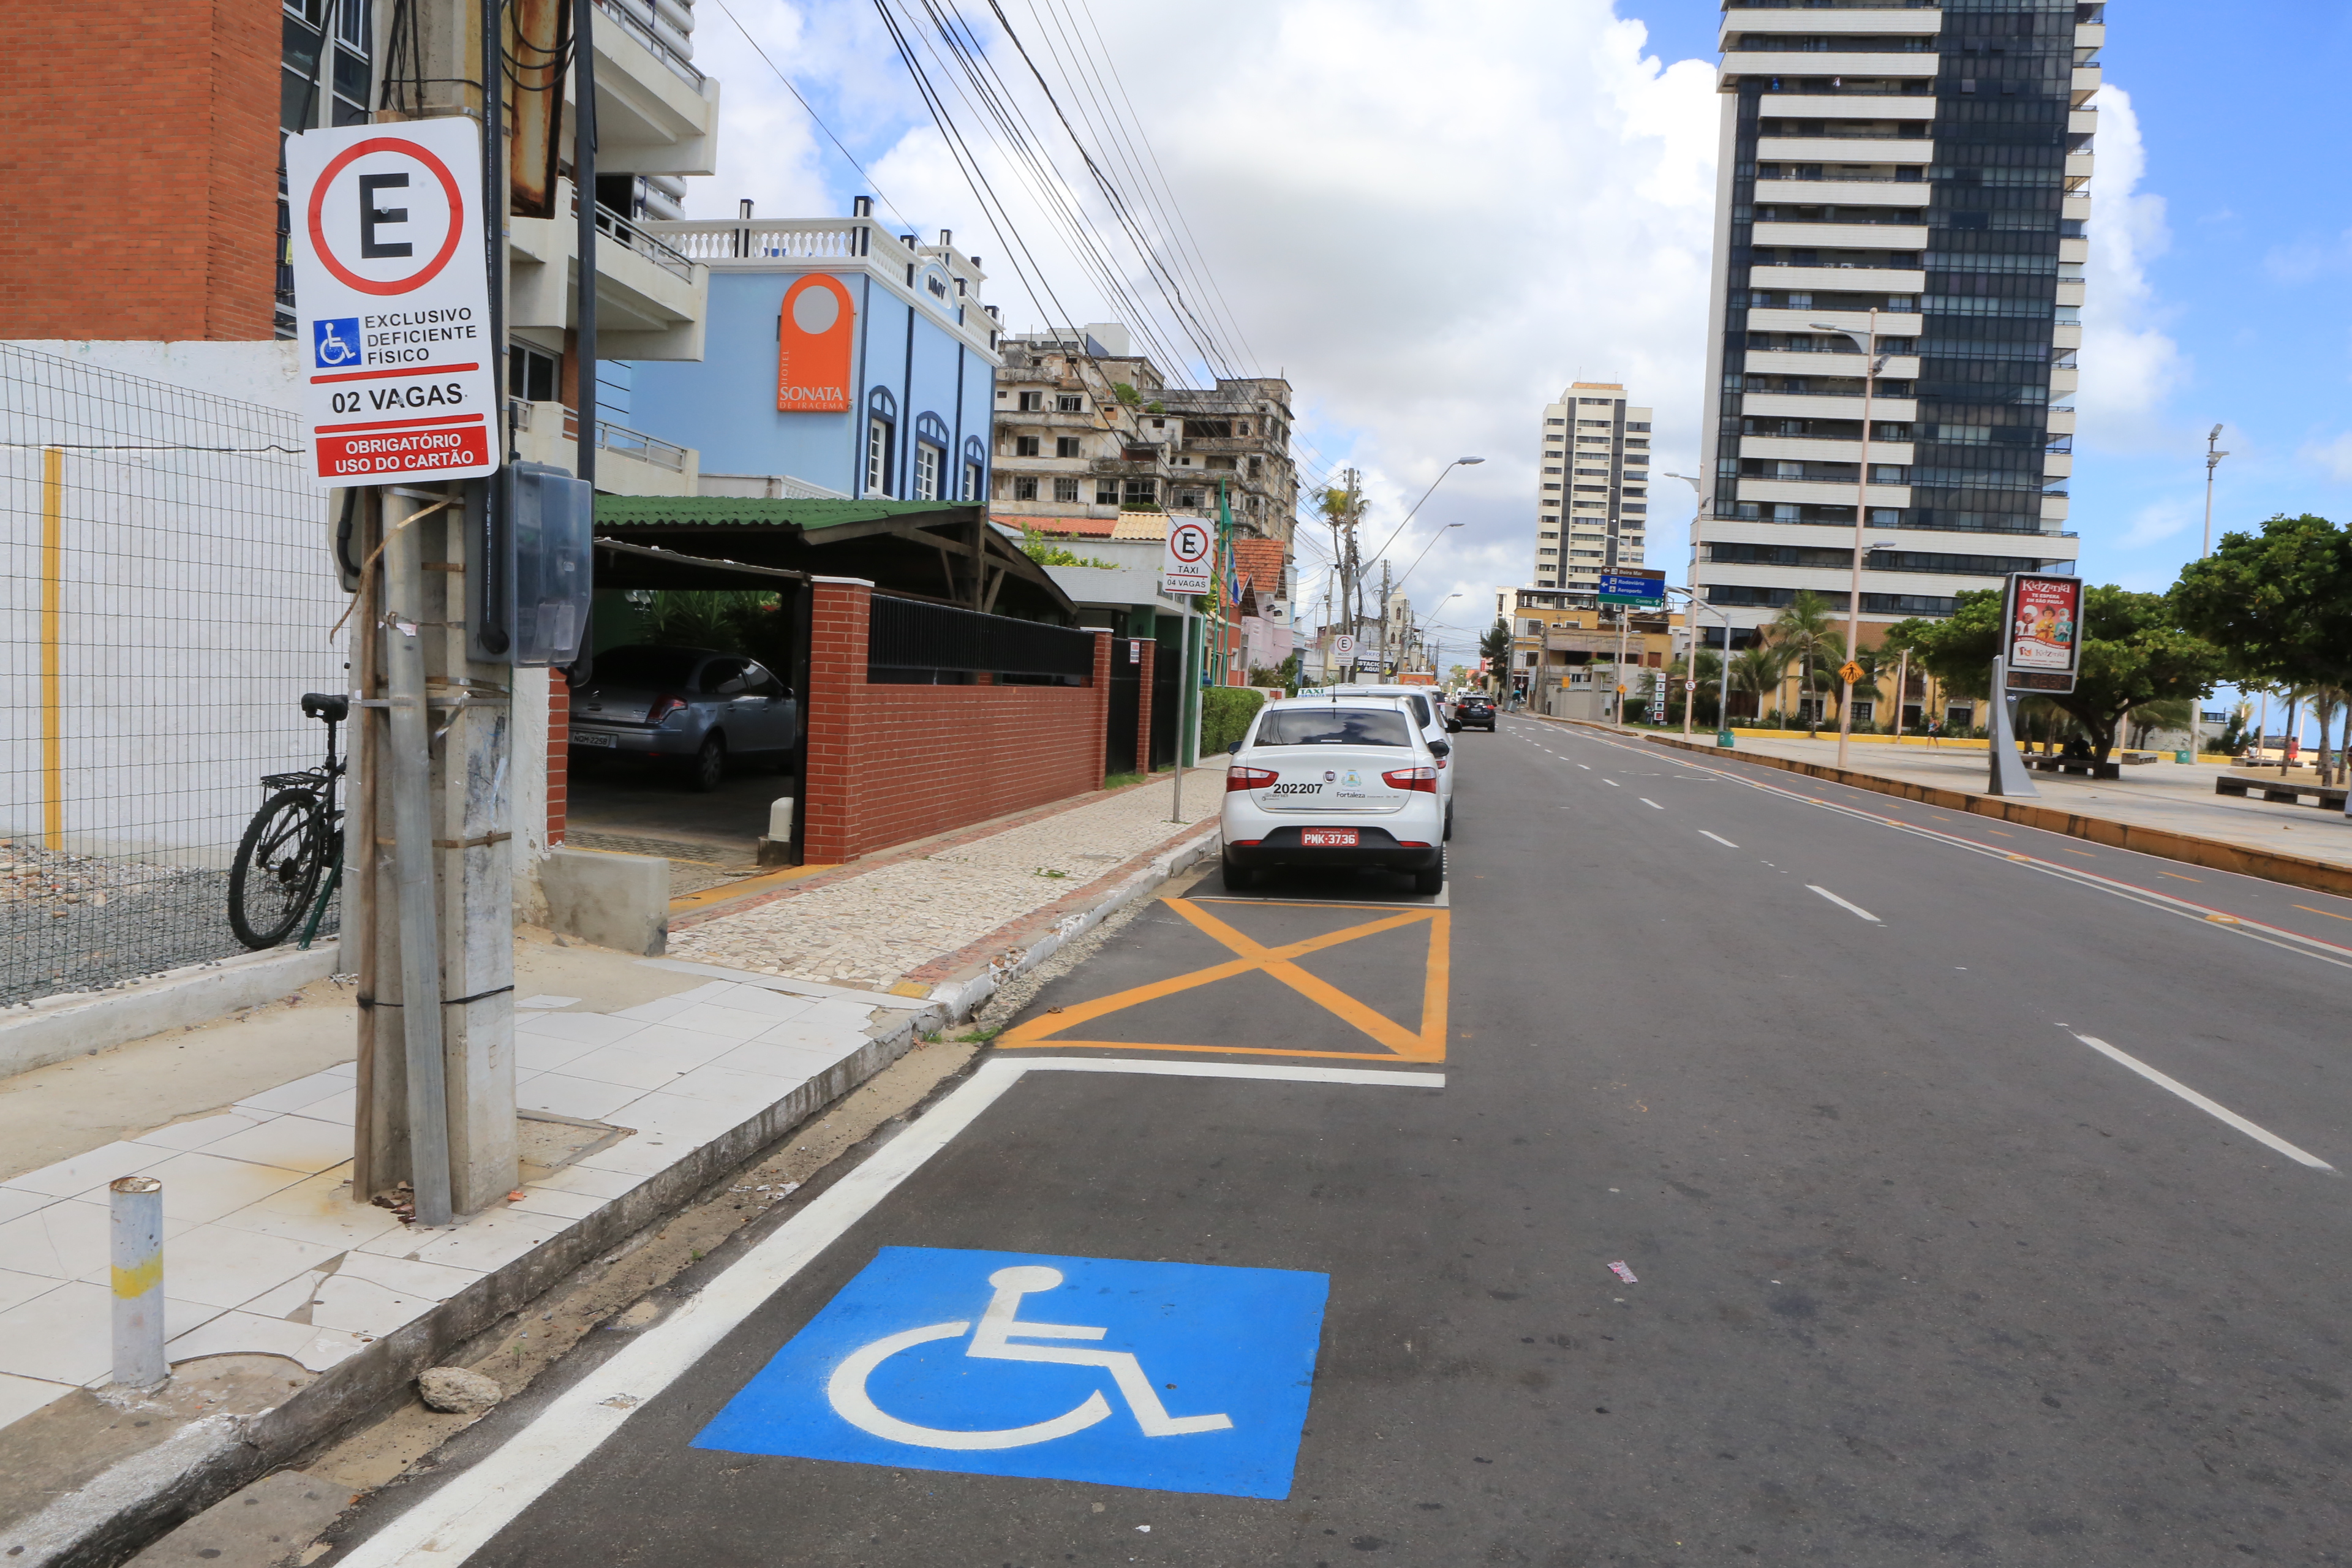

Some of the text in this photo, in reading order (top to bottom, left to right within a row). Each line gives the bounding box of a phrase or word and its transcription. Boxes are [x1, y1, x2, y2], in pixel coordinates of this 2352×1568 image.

[359, 172, 413, 258] E
[928, 274, 946, 300] MMV
[365, 307, 472, 329] EXCLUSIVO
[368, 325, 477, 347] DEFICIENTE
[368, 347, 429, 365] FÍSICO
[781, 350, 790, 385] HOTEL
[332, 382, 463, 413] 02 VAGAS
[780, 386, 843, 401] SONATA
[345, 432, 462, 455] OBRIGATÓRIO
[335, 449, 475, 474] USO DO CARTÃO
[1182, 533, 1196, 554] E
[1178, 565, 1199, 574] TÁXI
[1178, 579, 1206, 588] VAGAS
[2021, 579, 2070, 593] KidZania
[1341, 639, 1348, 648] E
[1273, 783, 1323, 794] 202207
